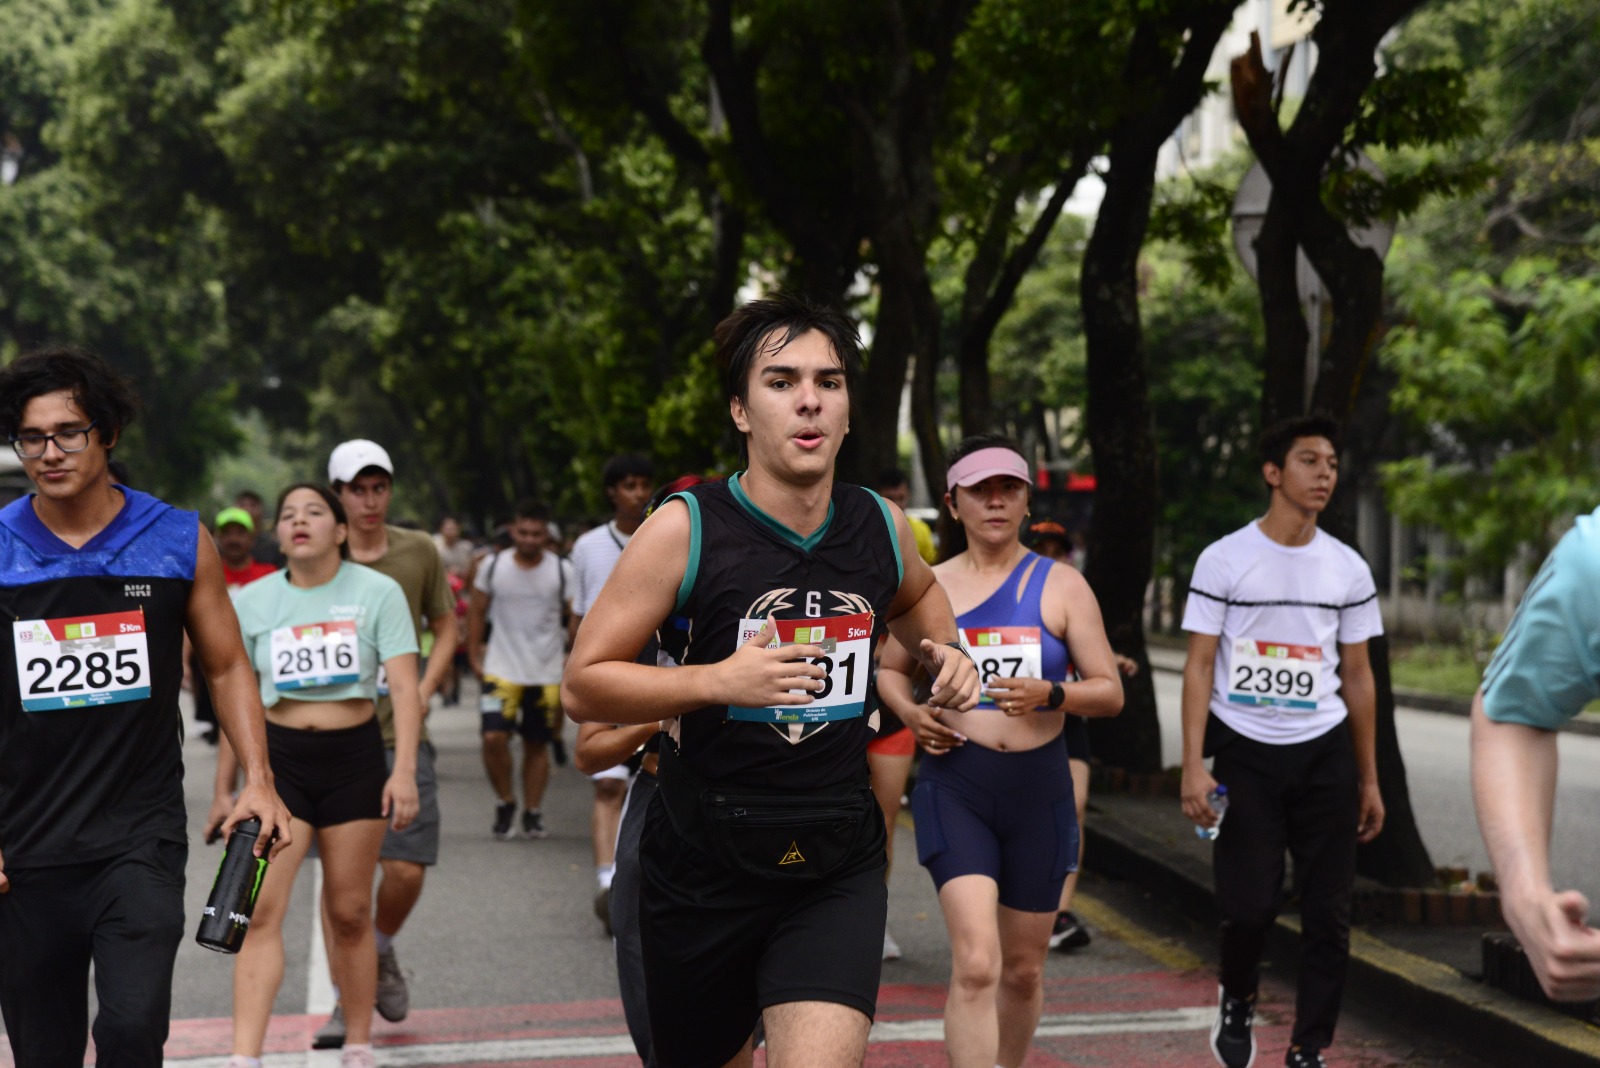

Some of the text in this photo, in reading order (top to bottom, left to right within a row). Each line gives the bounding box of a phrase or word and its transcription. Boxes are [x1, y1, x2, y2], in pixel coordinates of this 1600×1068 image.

[124, 584, 151, 597] NKI
[805, 590, 822, 618] 6
[26, 648, 141, 695] 2285
[277, 643, 353, 676] 2816
[1234, 665, 1314, 697] 2399
